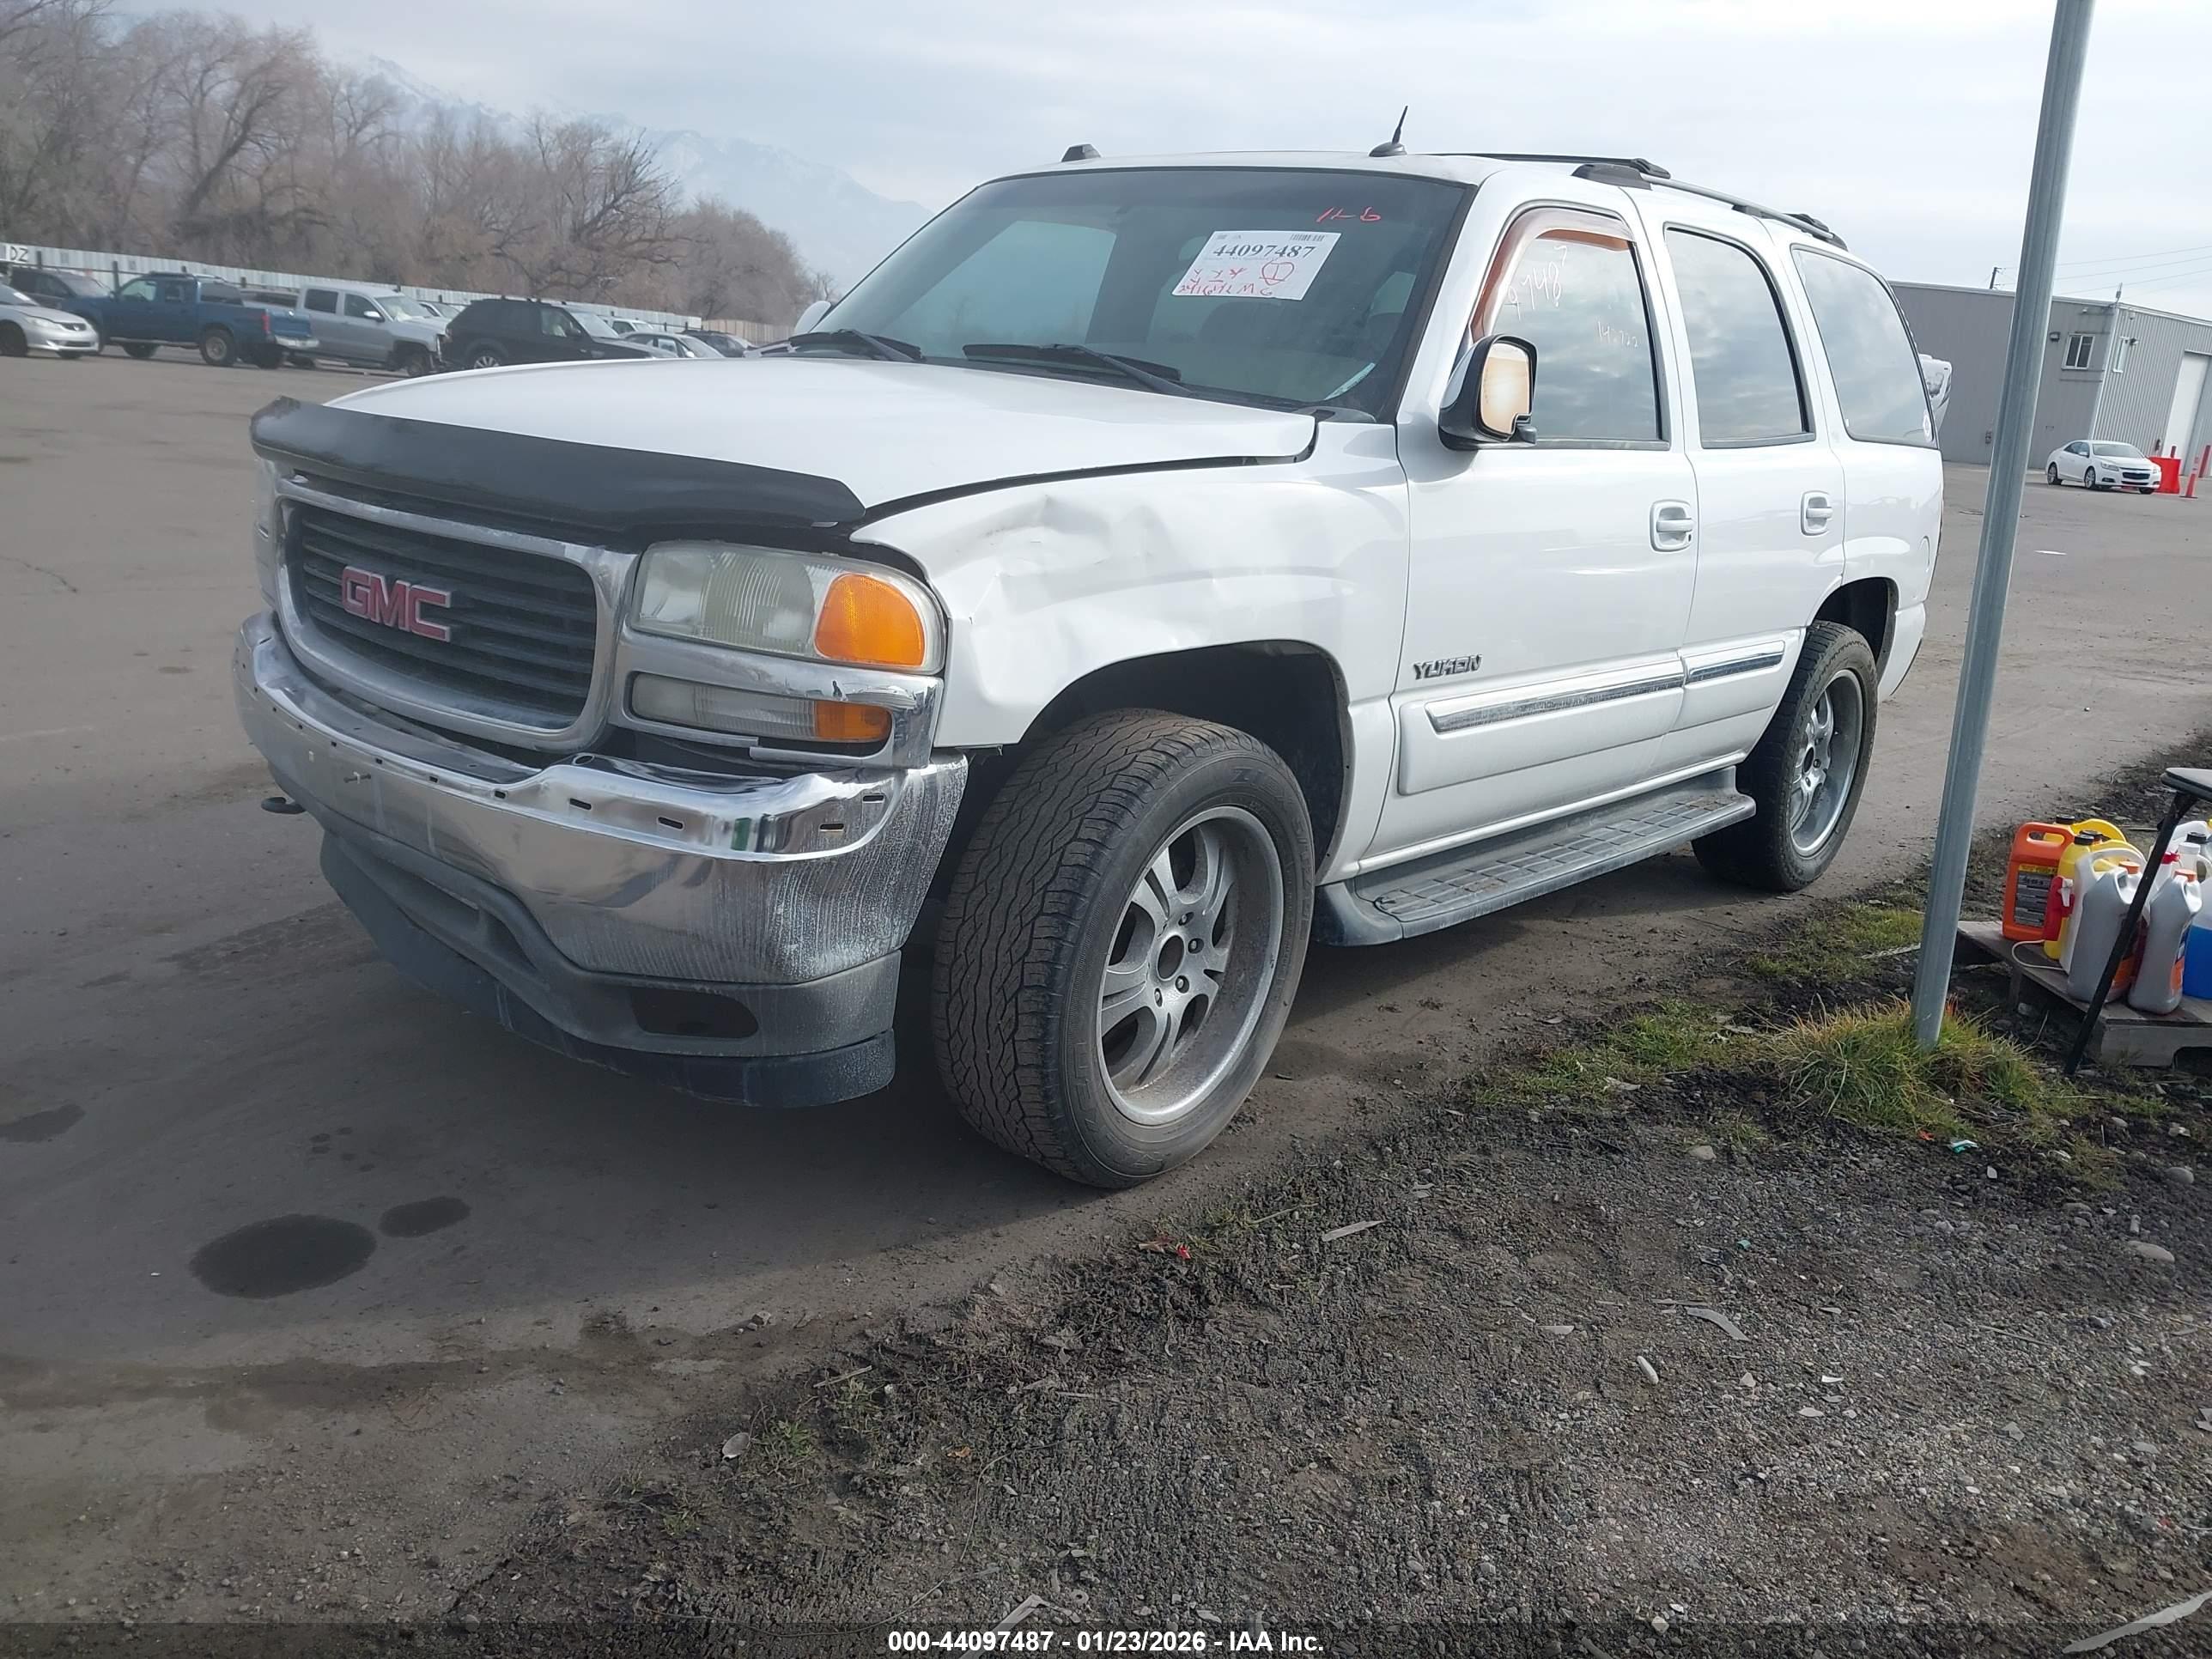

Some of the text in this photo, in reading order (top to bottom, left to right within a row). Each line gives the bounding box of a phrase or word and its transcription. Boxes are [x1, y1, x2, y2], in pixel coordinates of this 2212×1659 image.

[1212, 244, 1316, 259] 44097487
[341, 565, 452, 642] GMC
[1413, 653, 1484, 680] YUKON
